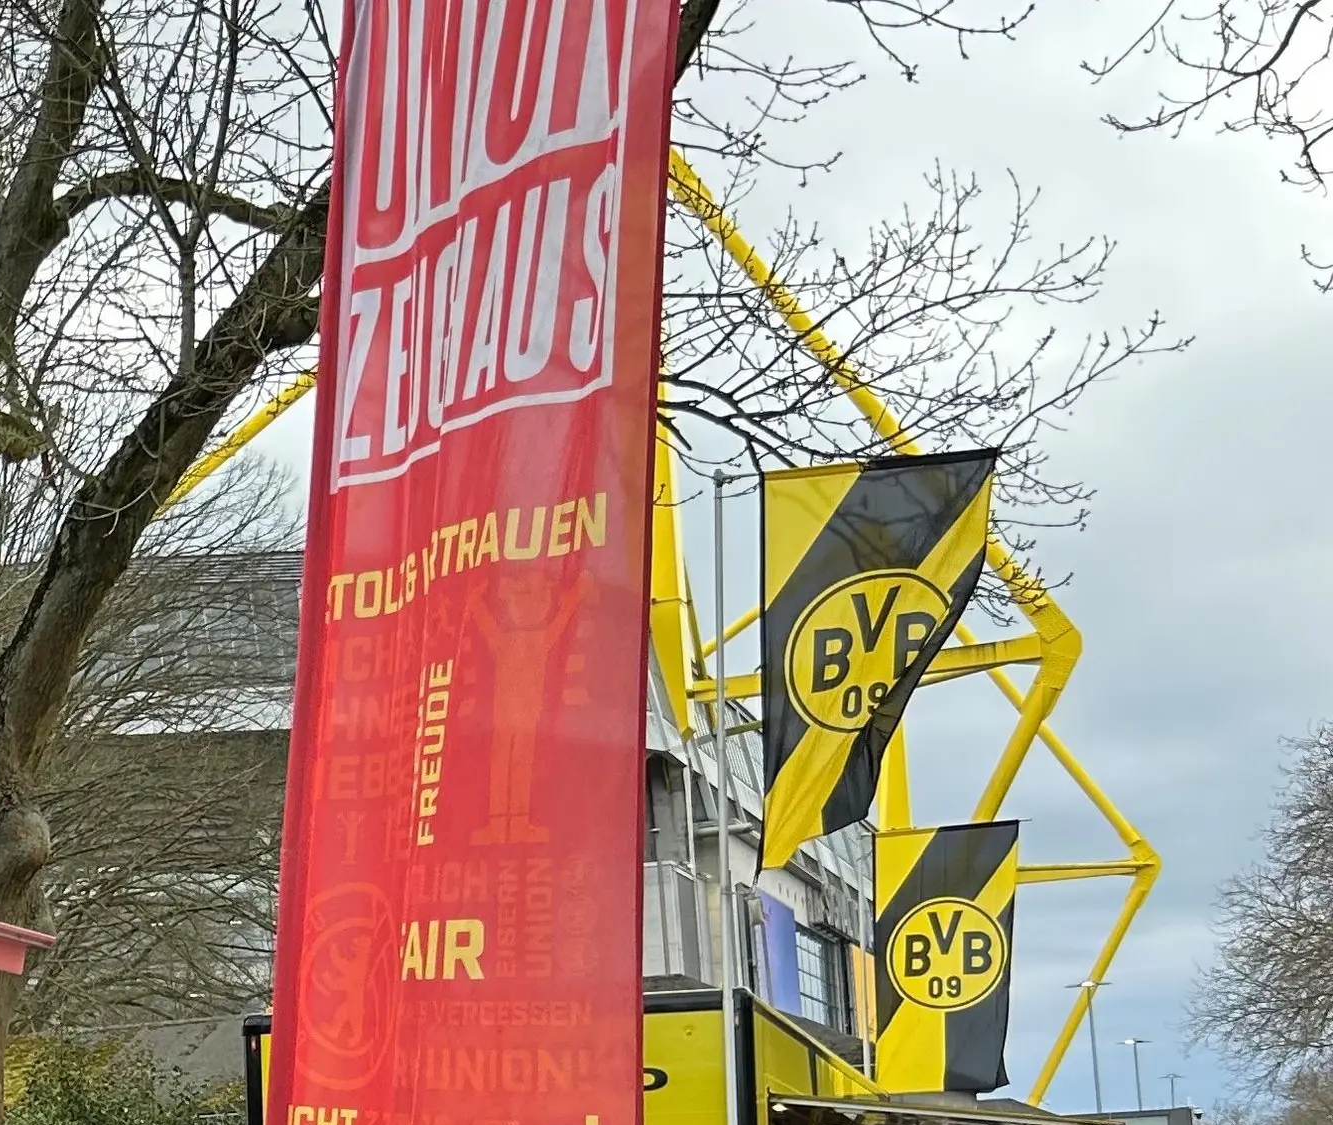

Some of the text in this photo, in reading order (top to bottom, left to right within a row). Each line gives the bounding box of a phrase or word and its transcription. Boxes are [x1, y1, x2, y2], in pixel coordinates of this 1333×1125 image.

[812, 584, 941, 694] BVB
[416, 658, 454, 846] FREUDE
[903, 909, 992, 999] BVB 09
